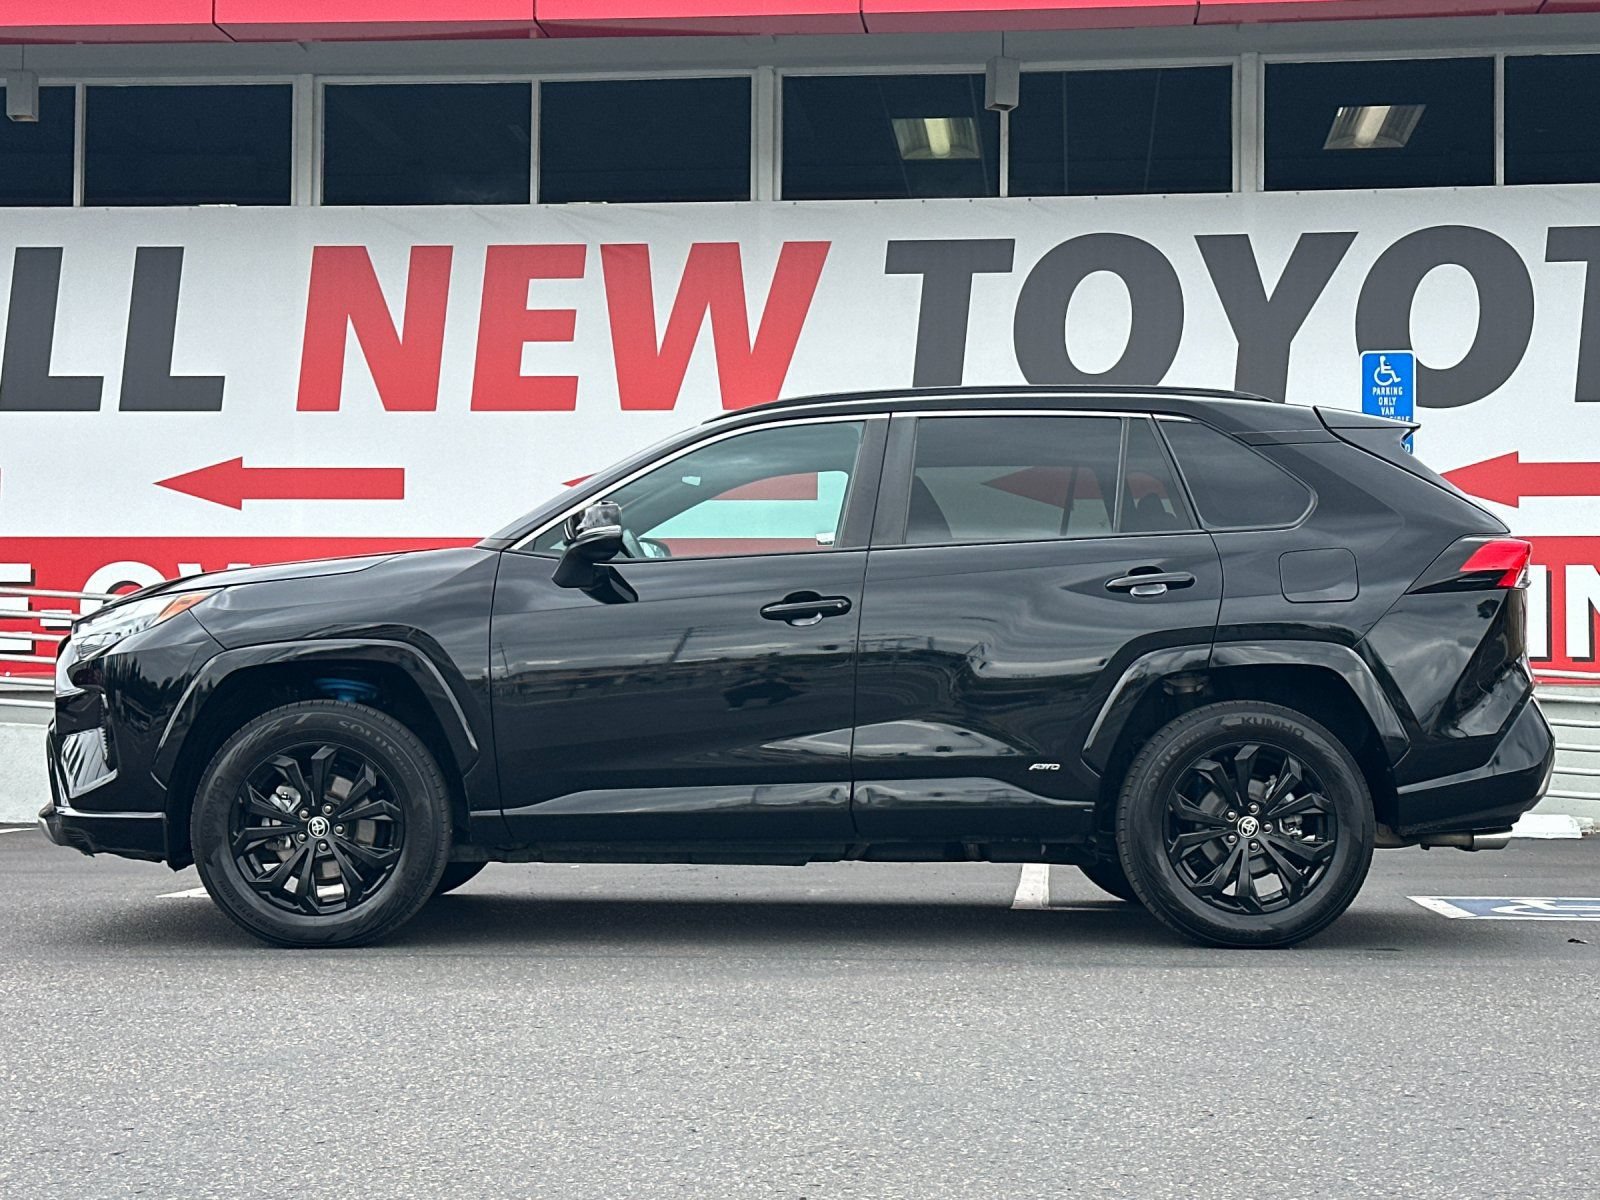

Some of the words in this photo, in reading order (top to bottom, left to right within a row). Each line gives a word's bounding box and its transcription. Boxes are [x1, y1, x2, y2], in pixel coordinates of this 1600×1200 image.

[297, 241, 832, 411] NEW
[1372, 386, 1403, 396] PARKING
[1378, 396, 1397, 406] ONLY
[1380, 406, 1395, 416] VAN
[1240, 716, 1305, 738] KUMHO
